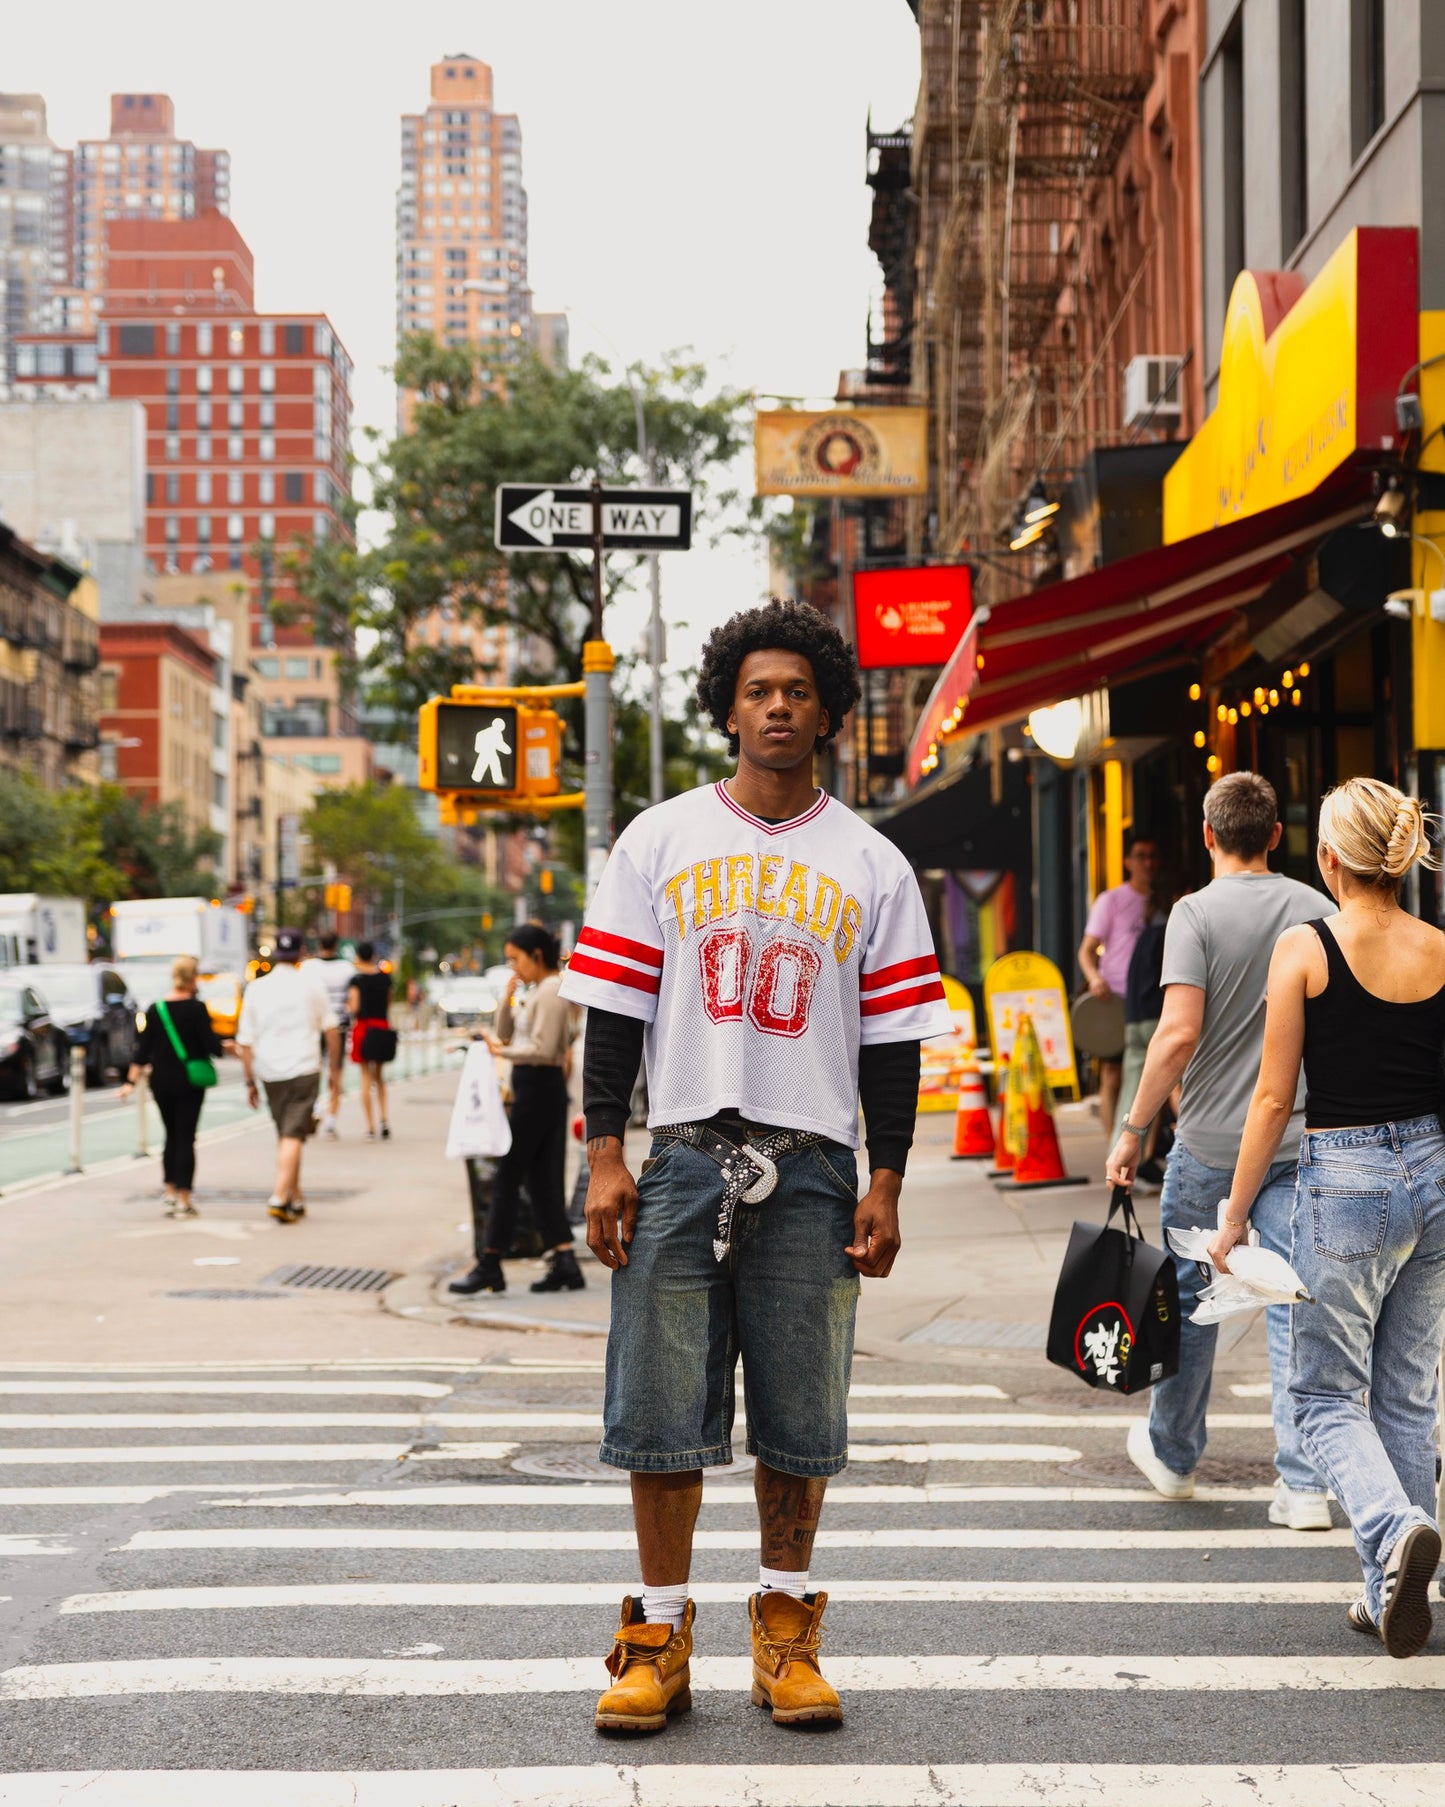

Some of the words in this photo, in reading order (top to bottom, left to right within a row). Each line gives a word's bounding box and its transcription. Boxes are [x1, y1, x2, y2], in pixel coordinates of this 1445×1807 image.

[529, 506, 581, 530] ONE
[611, 508, 666, 532] WAY
[664, 852, 863, 966] THREADS
[698, 926, 822, 1040] 00
